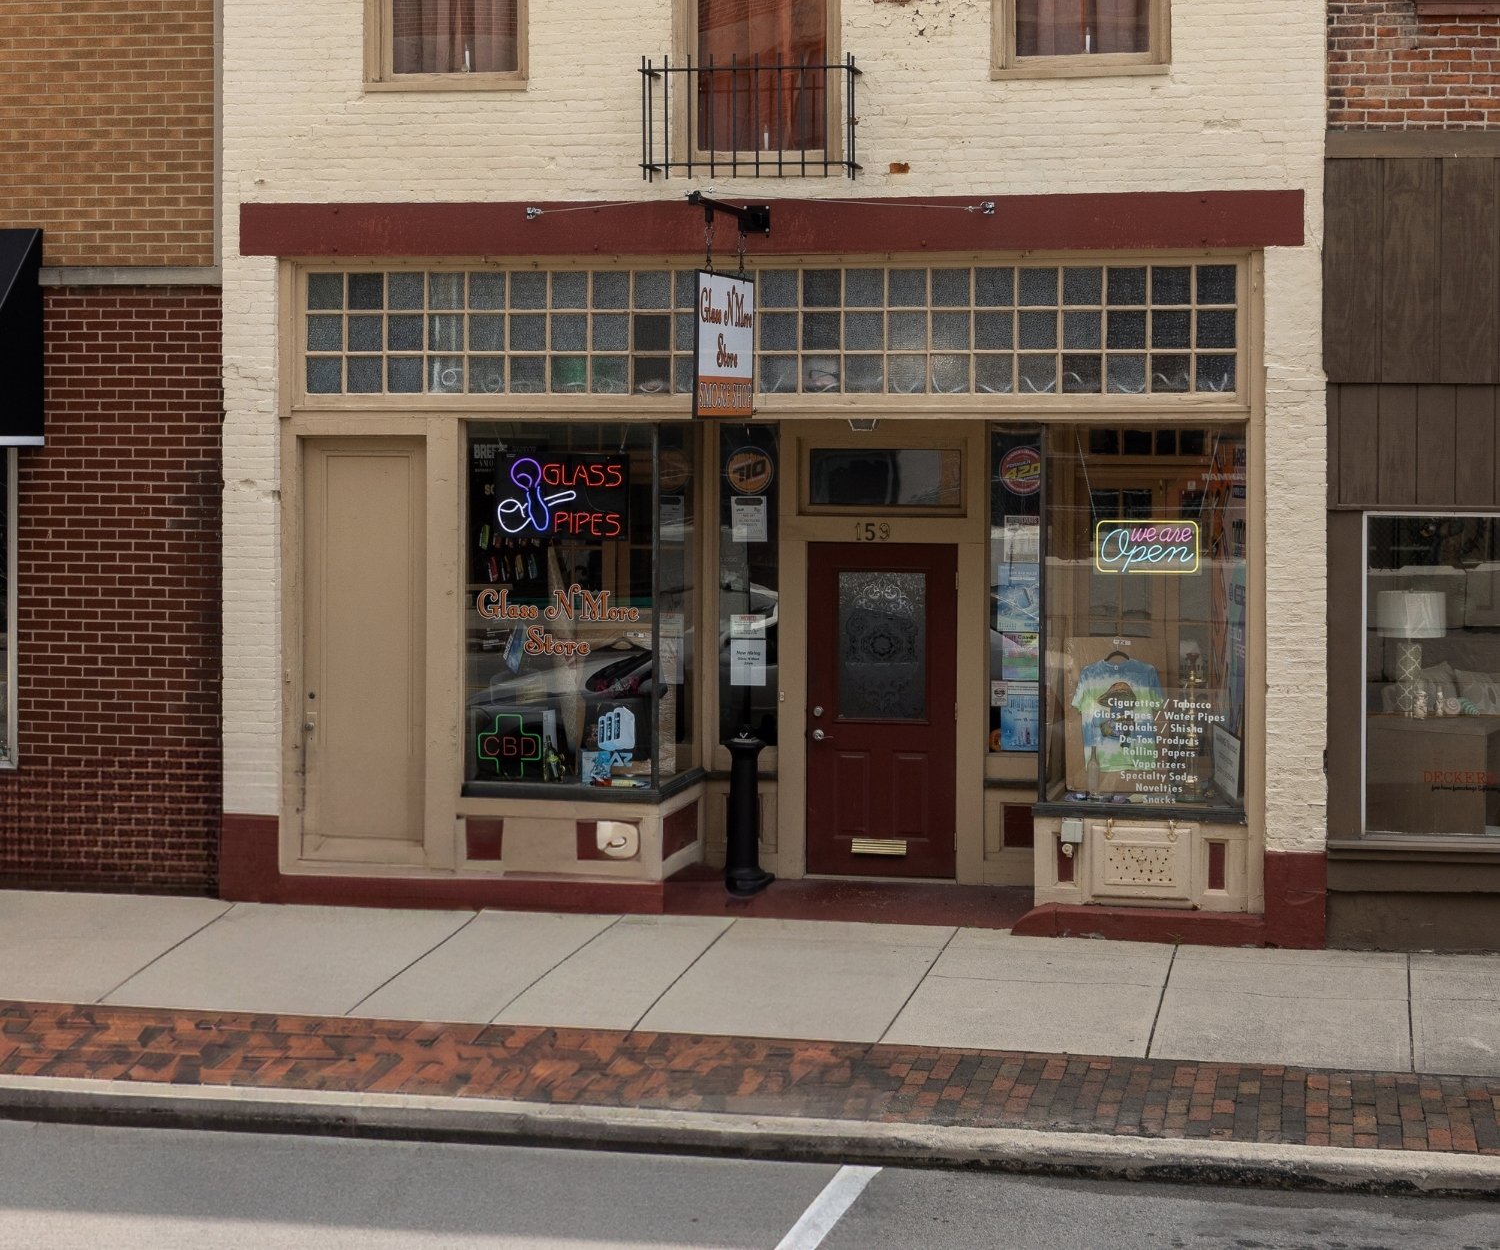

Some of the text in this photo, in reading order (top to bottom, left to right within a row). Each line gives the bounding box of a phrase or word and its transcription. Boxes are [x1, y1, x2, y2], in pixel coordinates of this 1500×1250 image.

[700, 286, 722, 325] Glass
[735, 293, 752, 328] More
[716, 333, 738, 368] Store
[699, 382, 753, 408] SMOKE SHOP
[543, 463, 622, 487] GLASS
[1005, 462, 1041, 478] 420
[555, 512, 620, 536] PIPES
[855, 522, 891, 541] 159
[1130, 526, 1193, 542] we are
[1101, 528, 1194, 573] Open
[477, 583, 639, 622] Glass N More
[524, 624, 591, 656] Store
[1108, 698, 1160, 708] Cigarettes
[1173, 699, 1212, 709] Tobacco
[1094, 710, 1121, 719] Glass
[1124, 710, 1152, 722] Pipes
[1164, 712, 1195, 721] Water
[1198, 713, 1226, 723] Pipes
[1115, 722, 1158, 732] Hookahs
[1170, 724, 1203, 734] Shisha
[484, 736, 536, 756] CBD
[1119, 735, 1199, 745] De-Tox Products
[1123, 747, 1195, 758] Rolling Papers
[1132, 759, 1186, 769] Vaporizers
[1120, 771, 1198, 782] Specialty Sodas
[1135, 783, 1183, 793] Novelties
[1143, 796, 1176, 804] Snacks
